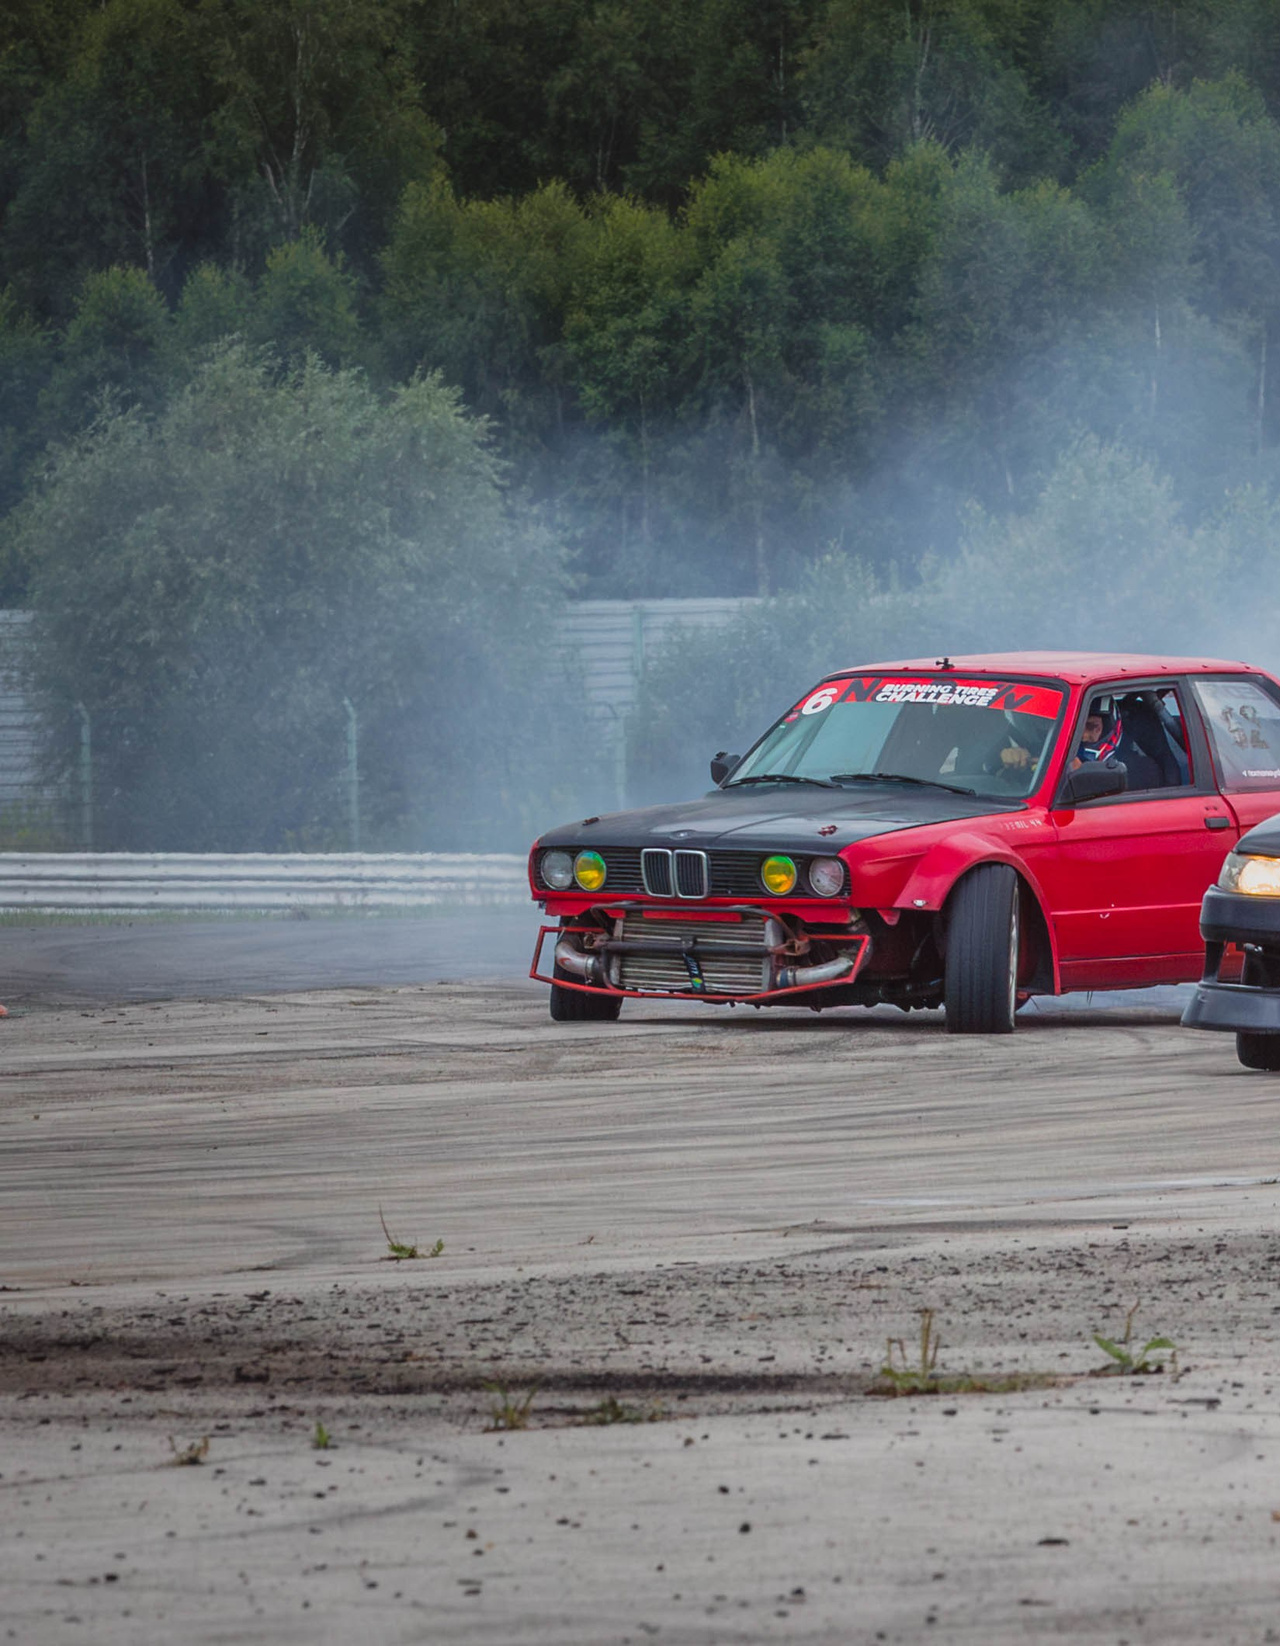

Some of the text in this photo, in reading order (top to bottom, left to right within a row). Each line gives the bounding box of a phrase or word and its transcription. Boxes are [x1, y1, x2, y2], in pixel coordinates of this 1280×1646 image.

[881, 683, 951, 694] BURNING
[954, 686, 998, 697] TIRES
[801, 687, 838, 715] 6
[875, 692, 993, 707] CHALLENGE
